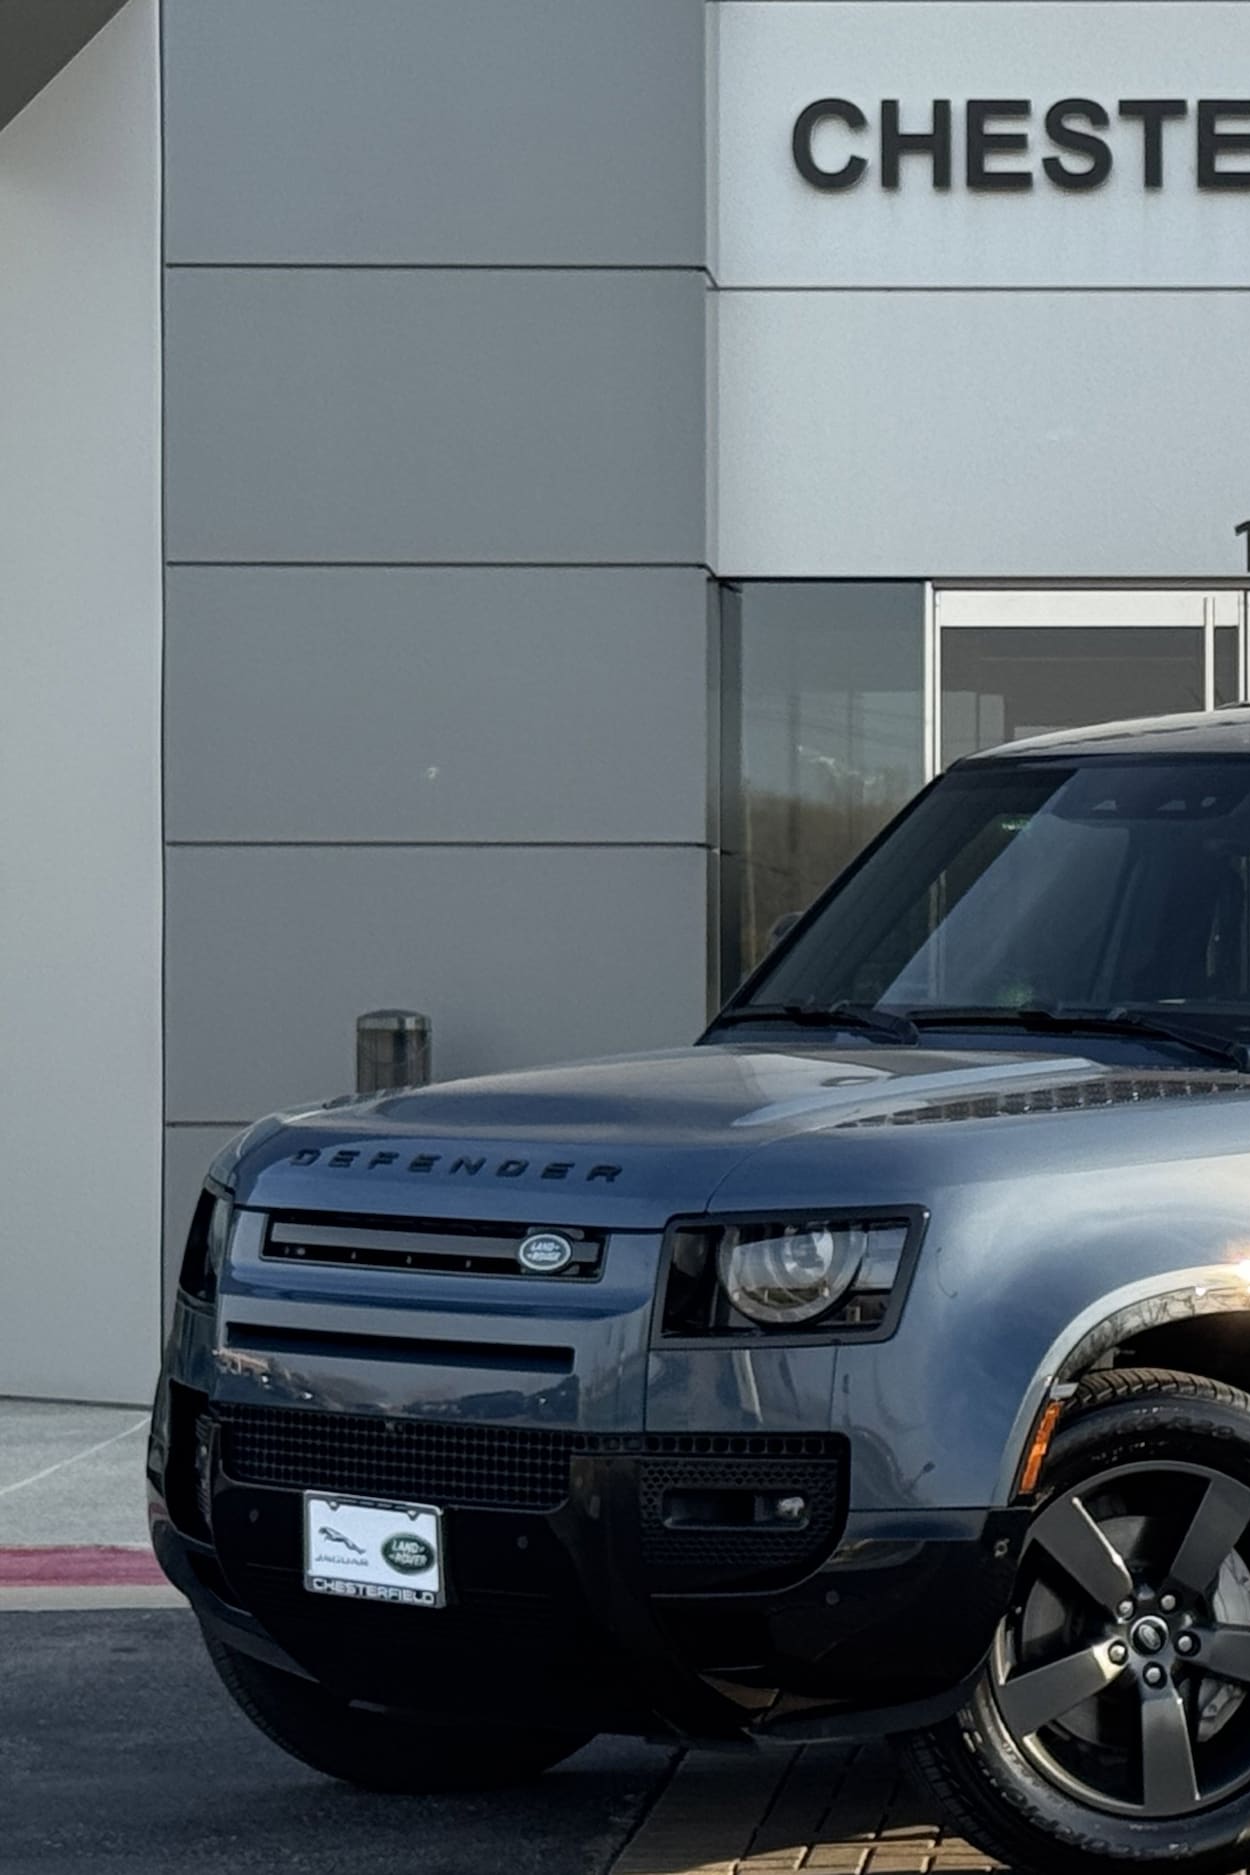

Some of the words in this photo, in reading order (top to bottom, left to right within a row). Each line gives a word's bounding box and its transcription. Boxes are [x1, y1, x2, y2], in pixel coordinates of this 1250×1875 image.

[290, 1149, 623, 1182] DEFENDER
[391, 1540, 419, 1554] LAND
[315, 1554, 369, 1566] JAGUAR
[394, 1553, 428, 1567] ROVER
[313, 1578, 435, 1604] CHESTERFIELD
